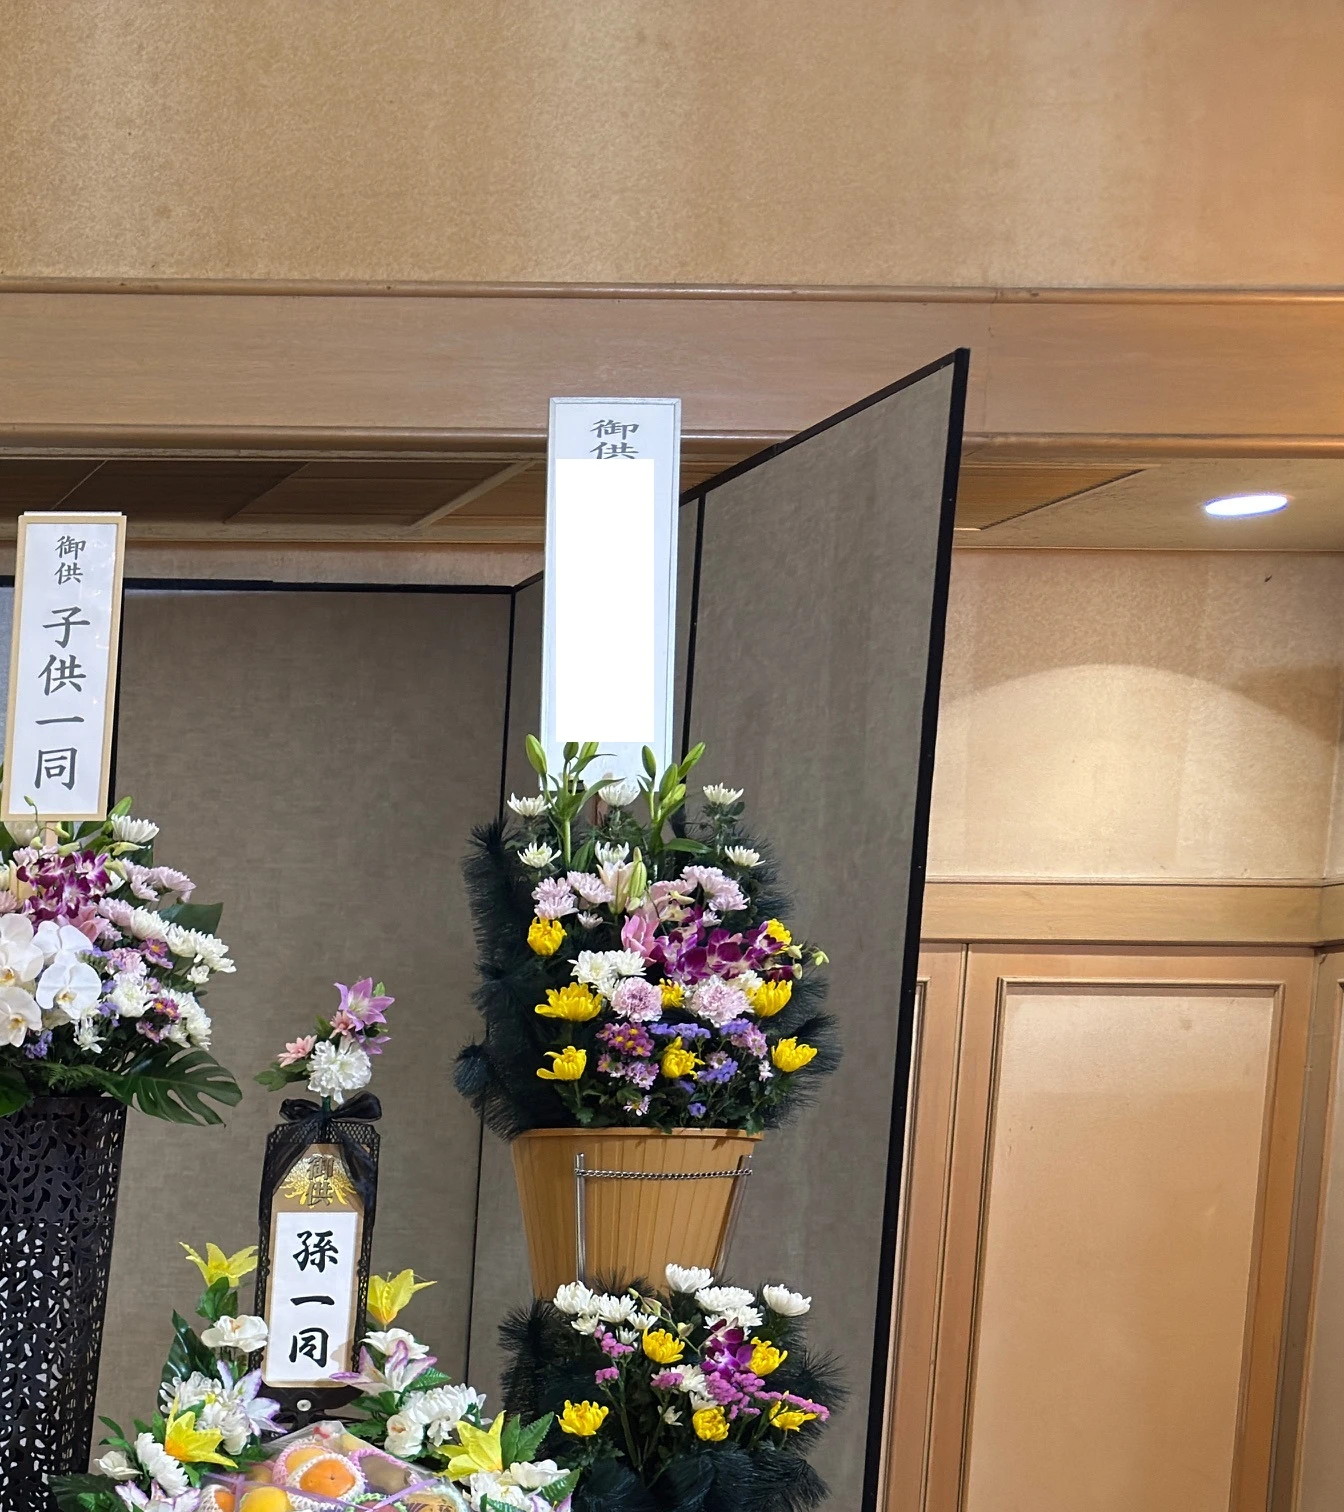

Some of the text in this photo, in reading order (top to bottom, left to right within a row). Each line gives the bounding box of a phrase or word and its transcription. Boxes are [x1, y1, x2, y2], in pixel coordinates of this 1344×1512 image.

[589, 418, 640, 460] 御供
[33, 535, 91, 791] 御供 子供一同
[306, 1156, 333, 1207] 御供
[288, 1229, 339, 1368] 孫一同
